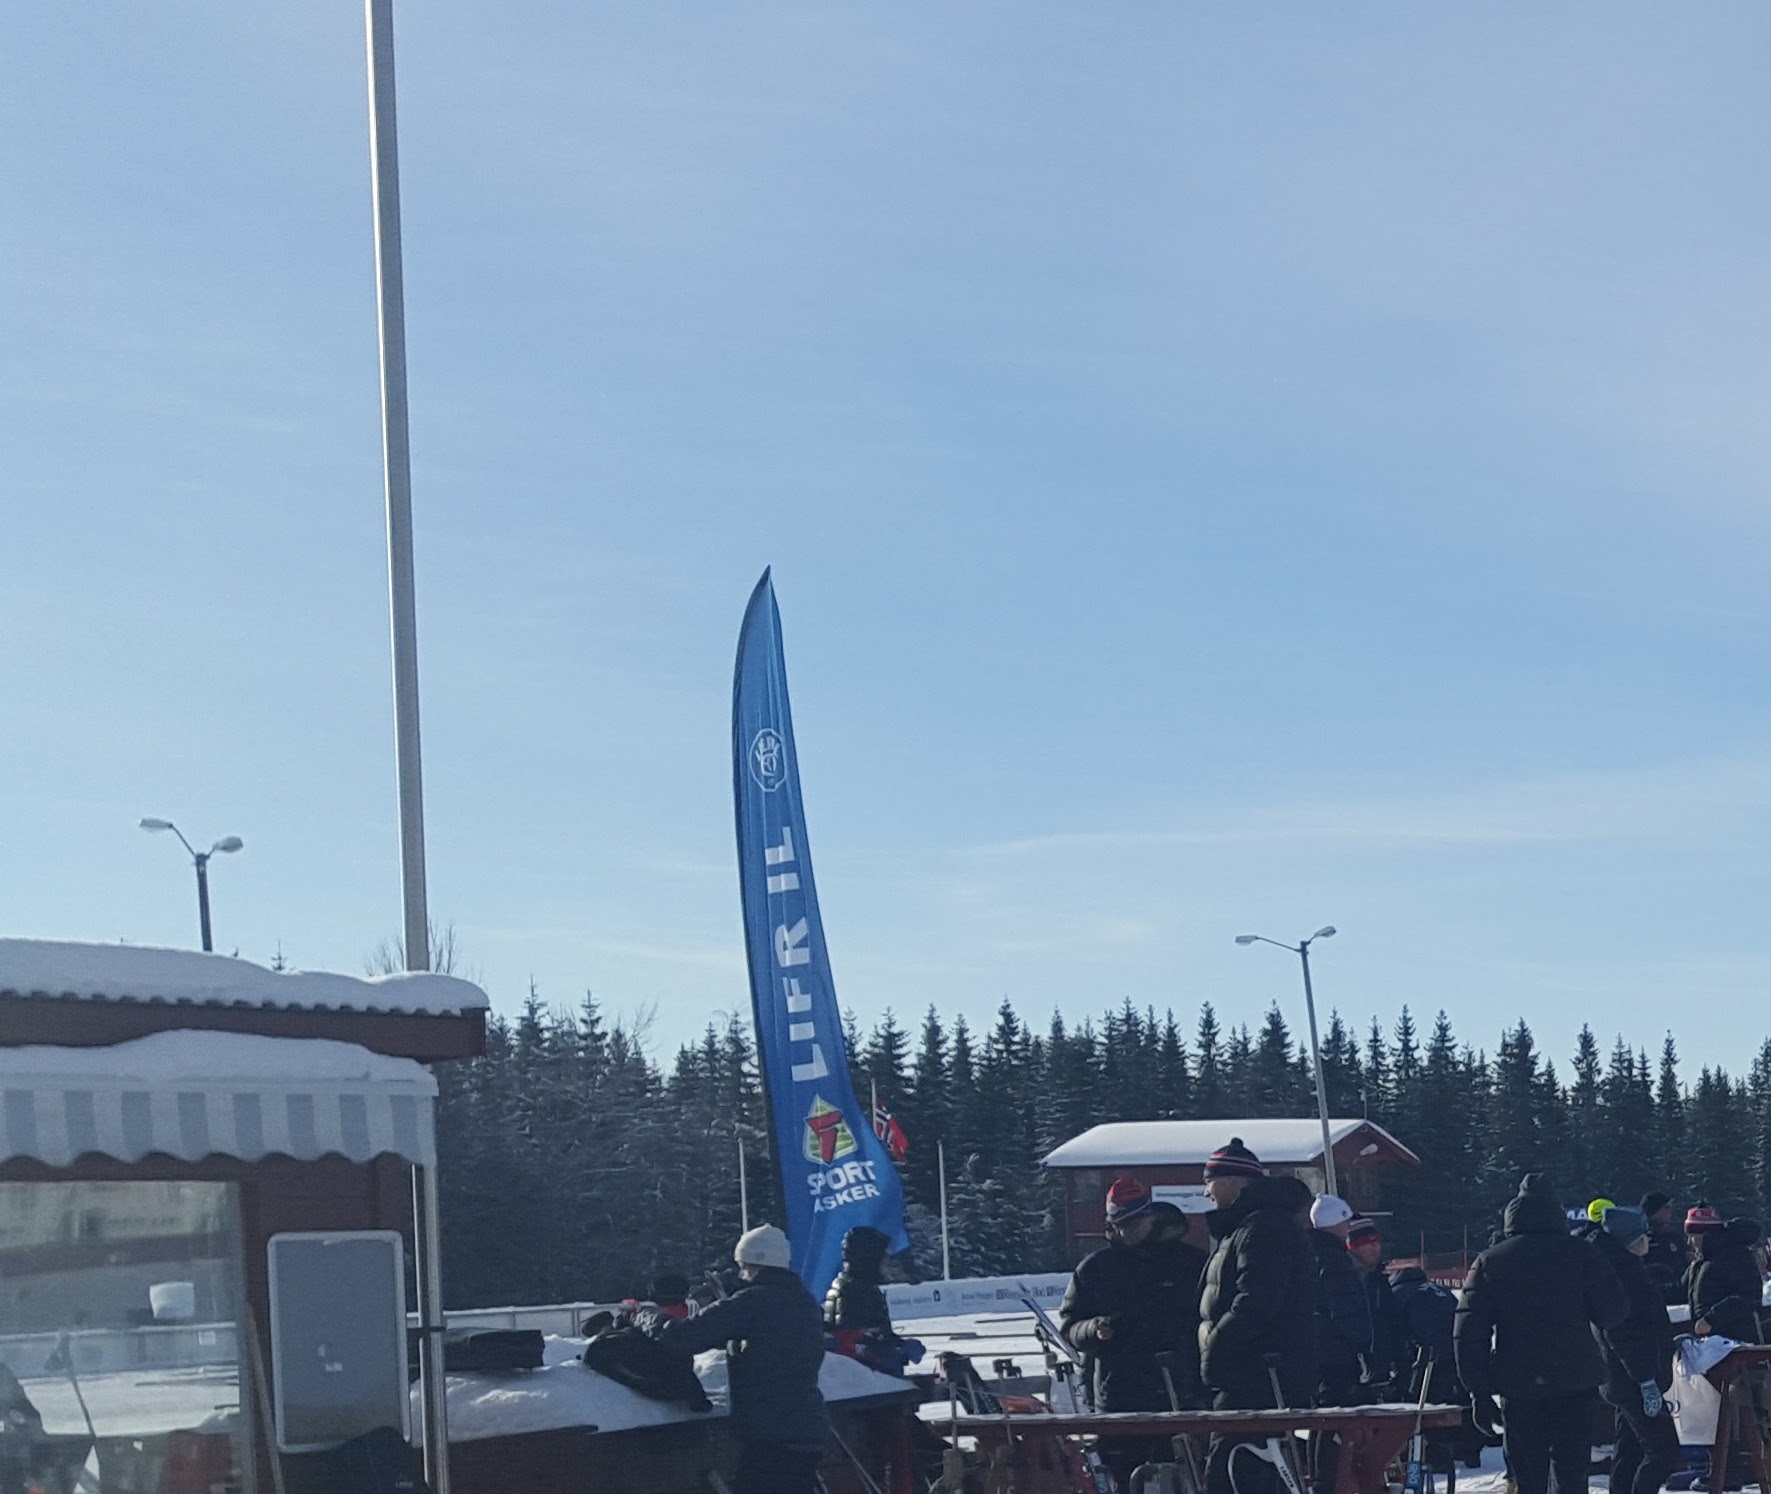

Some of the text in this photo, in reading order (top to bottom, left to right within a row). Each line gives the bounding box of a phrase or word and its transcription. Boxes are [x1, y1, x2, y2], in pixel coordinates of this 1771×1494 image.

[765, 826, 800, 894] IL
[807, 1160, 877, 1195] SPORT
[813, 1183, 881, 1213] ASKER
